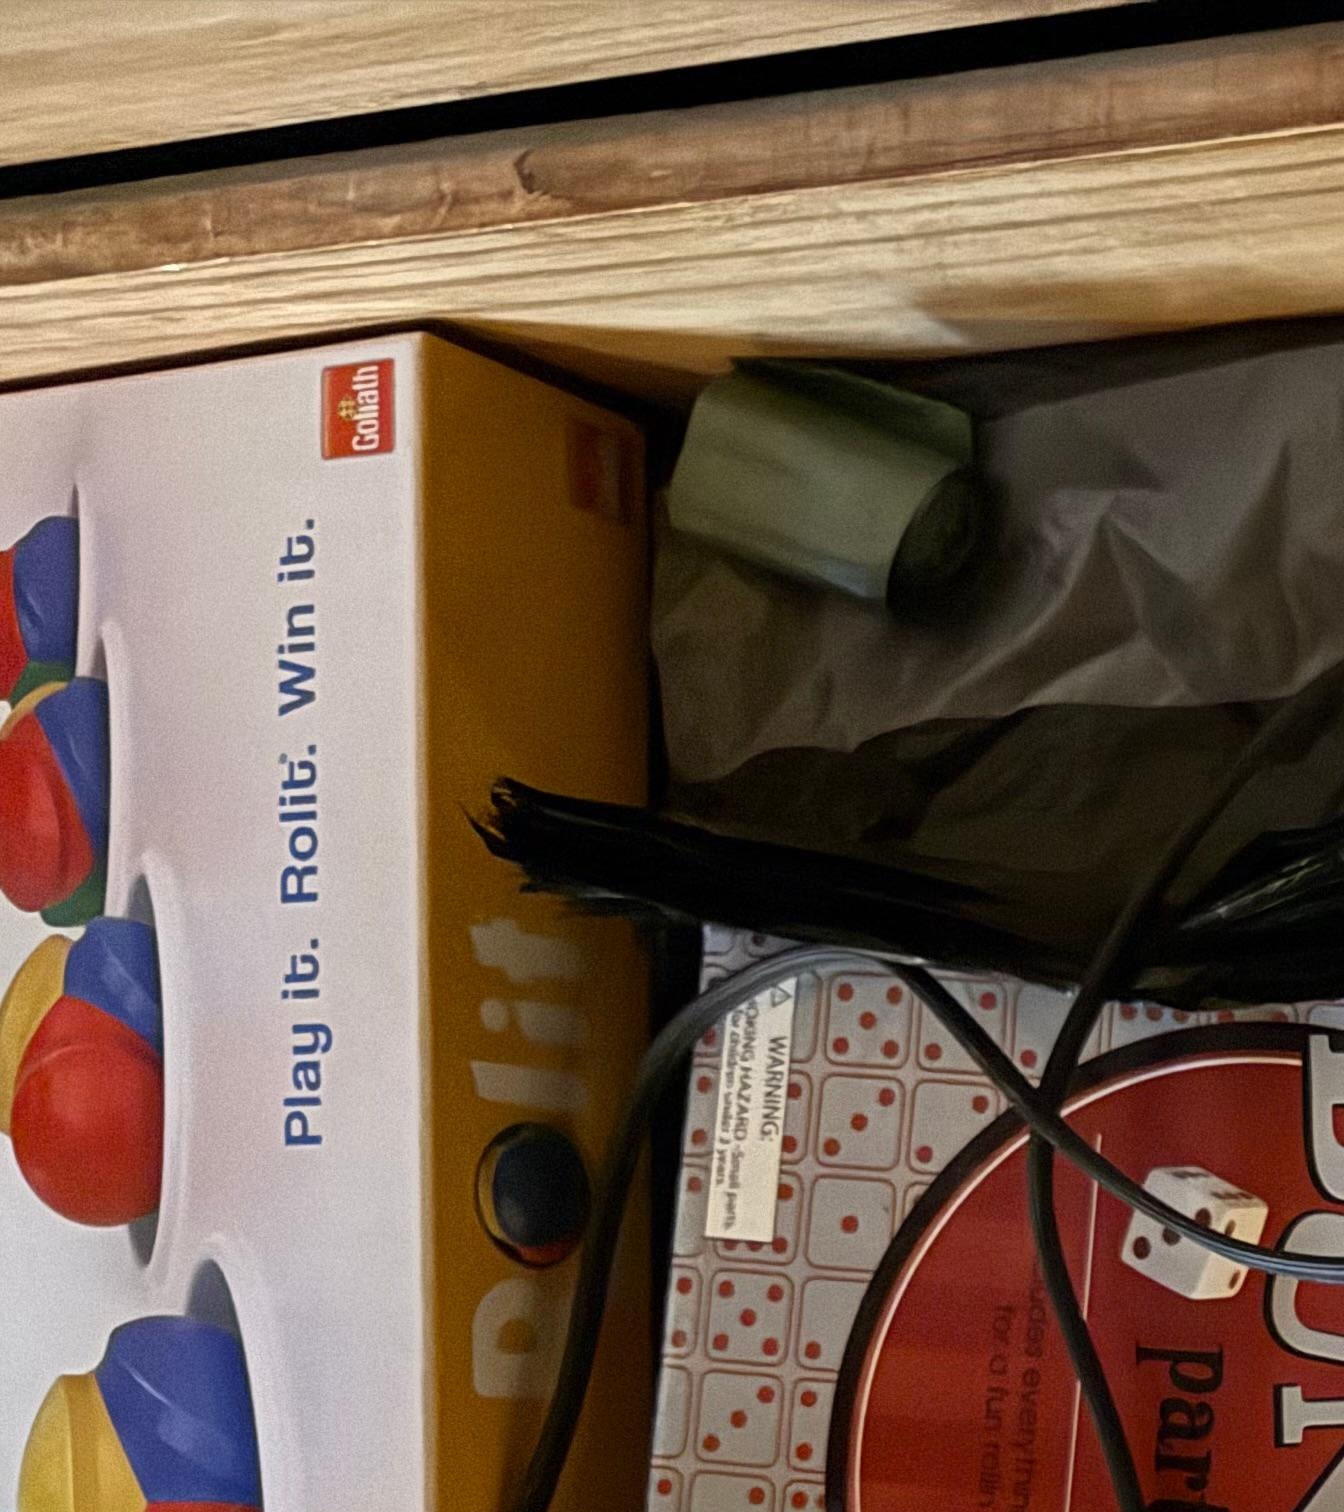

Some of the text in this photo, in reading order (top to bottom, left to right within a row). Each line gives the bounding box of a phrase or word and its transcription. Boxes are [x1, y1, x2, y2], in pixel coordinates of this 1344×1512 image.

[352, 365, 383, 451] Goliath
[276, 517, 316, 583] it.
[277, 601, 318, 717] Win
[281, 937, 320, 1001] it.
[283, 1019, 332, 1146] Play
[734, 1066, 753, 1141] HAZARD
[760, 1036, 788, 1143] WARNING:
